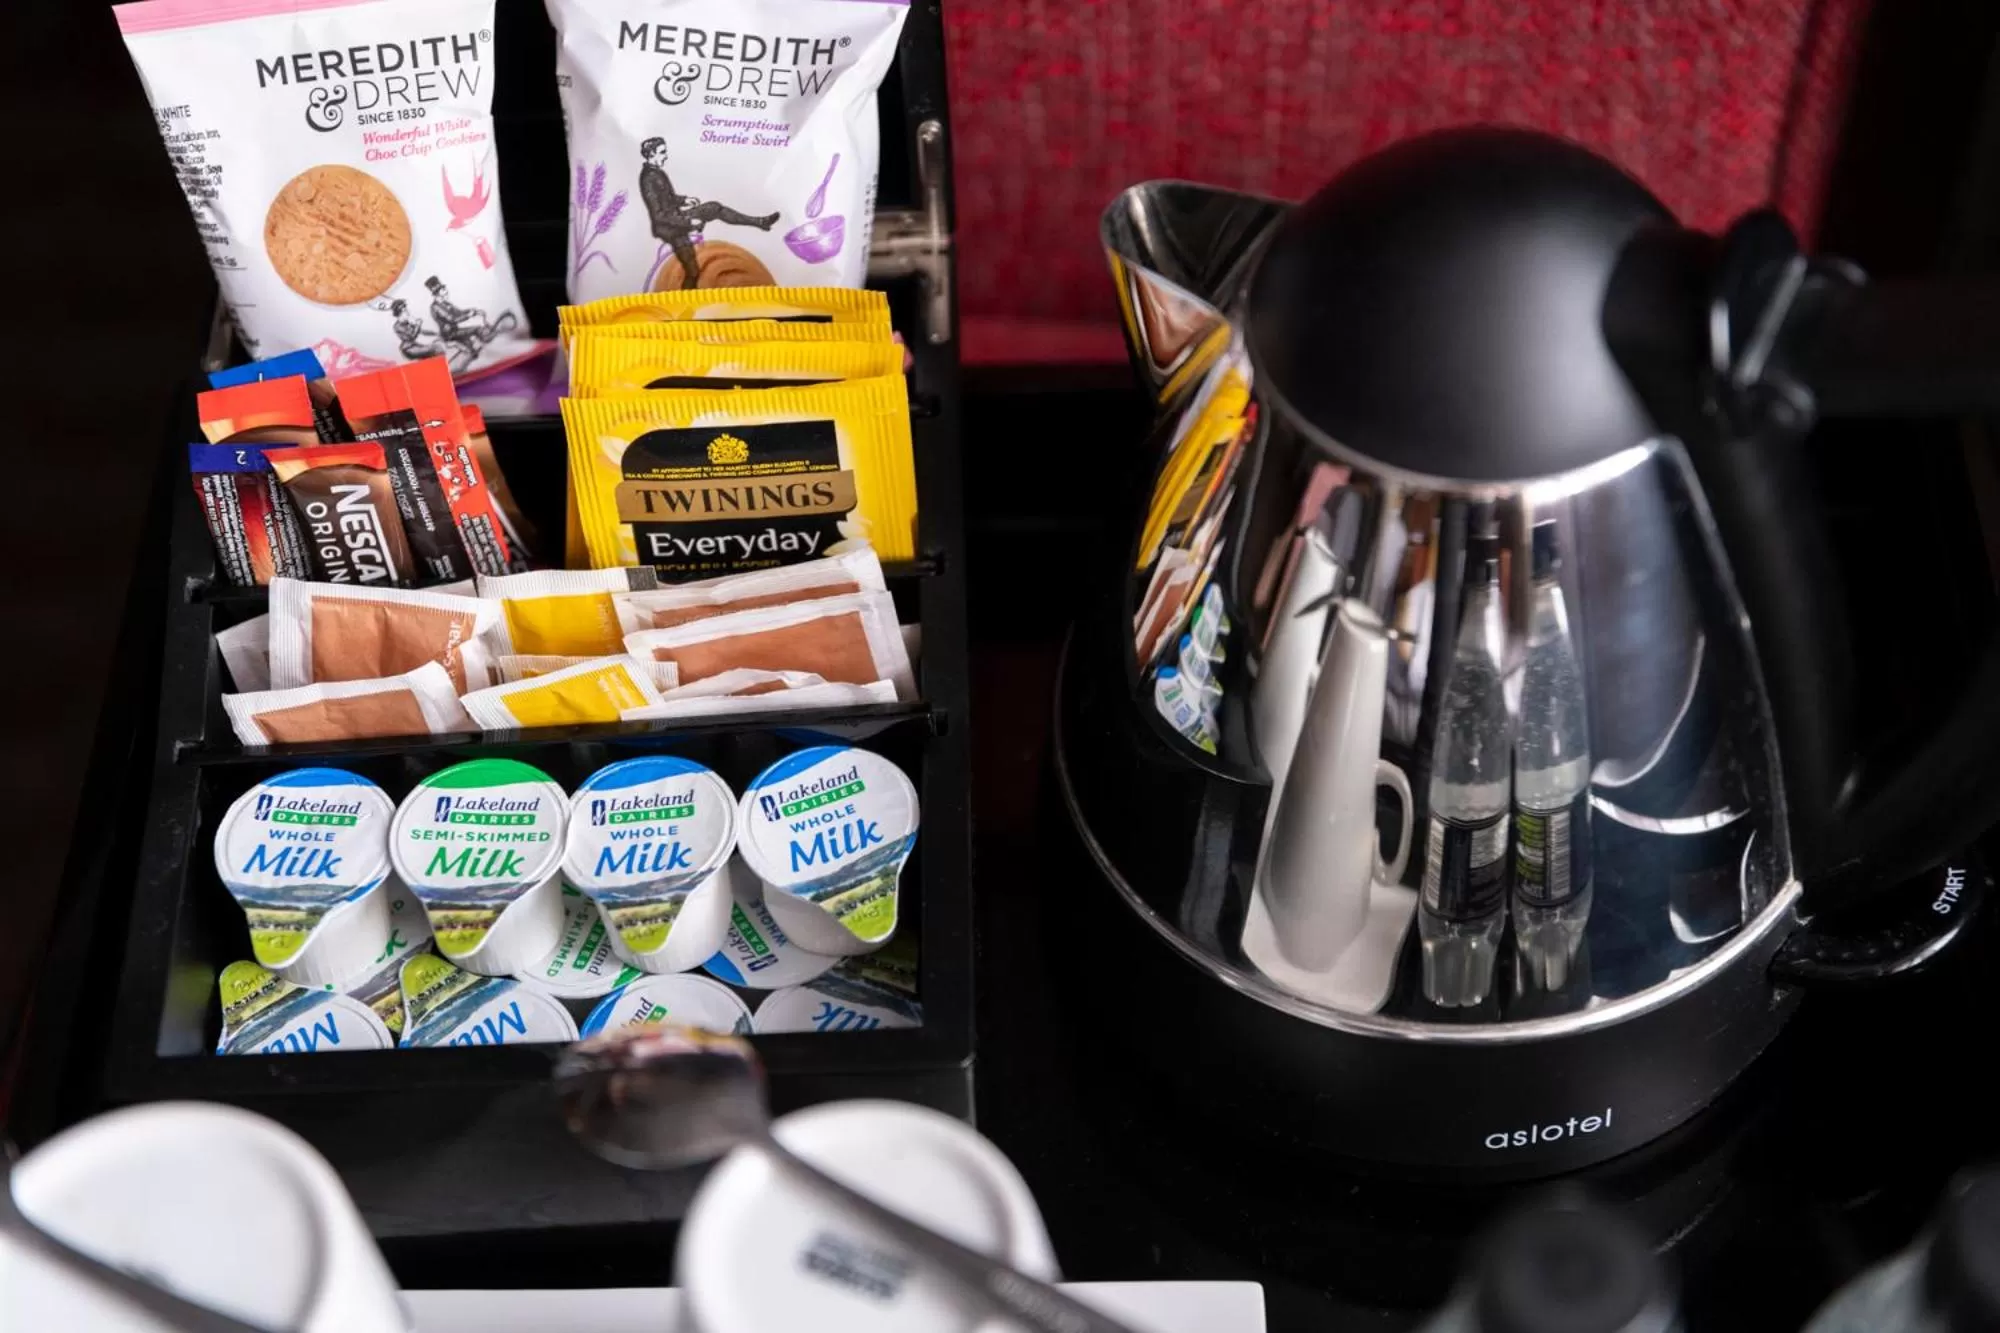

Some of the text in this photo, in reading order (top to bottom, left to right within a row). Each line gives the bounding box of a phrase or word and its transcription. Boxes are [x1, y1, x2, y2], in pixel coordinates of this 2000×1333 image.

[357, 107, 426, 126] SINCE 1830
[703, 95, 767, 110] SINCE 1830
[362, 118, 472, 146] Wonderful White
[701, 114, 790, 133] Scrumptious
[364, 130, 488, 162] Choc Chip Cookies
[700, 130, 790, 148] Shortie Swirl
[636, 481, 835, 514] TWININGS
[306, 502, 351, 583] ORIGIN
[330, 484, 398, 582] NESCA
[646, 528, 821, 559] Everyday
[778, 766, 859, 805] Lakeland
[785, 783, 861, 816] DAIRIES
[276, 795, 362, 815] Lakeland
[455, 796, 541, 812] Lakeland
[609, 789, 694, 812] Lakeland
[613, 806, 691, 822] DAIRIES
[277, 812, 352, 826] DAIRIES
[456, 813, 531, 824] DAIRIES
[790, 804, 857, 833] WHOLE
[269, 829, 336, 842] WHOLE
[410, 829, 550, 842] SEMI-SKIMMED
[610, 826, 678, 841] WHOLE
[789, 818, 884, 873] Milk
[243, 844, 343, 878] Milk
[425, 846, 527, 878] Milk
[594, 841, 693, 877] Milk
[1931, 866, 1967, 914] START
[1484, 1107, 1612, 1149] aslotel
